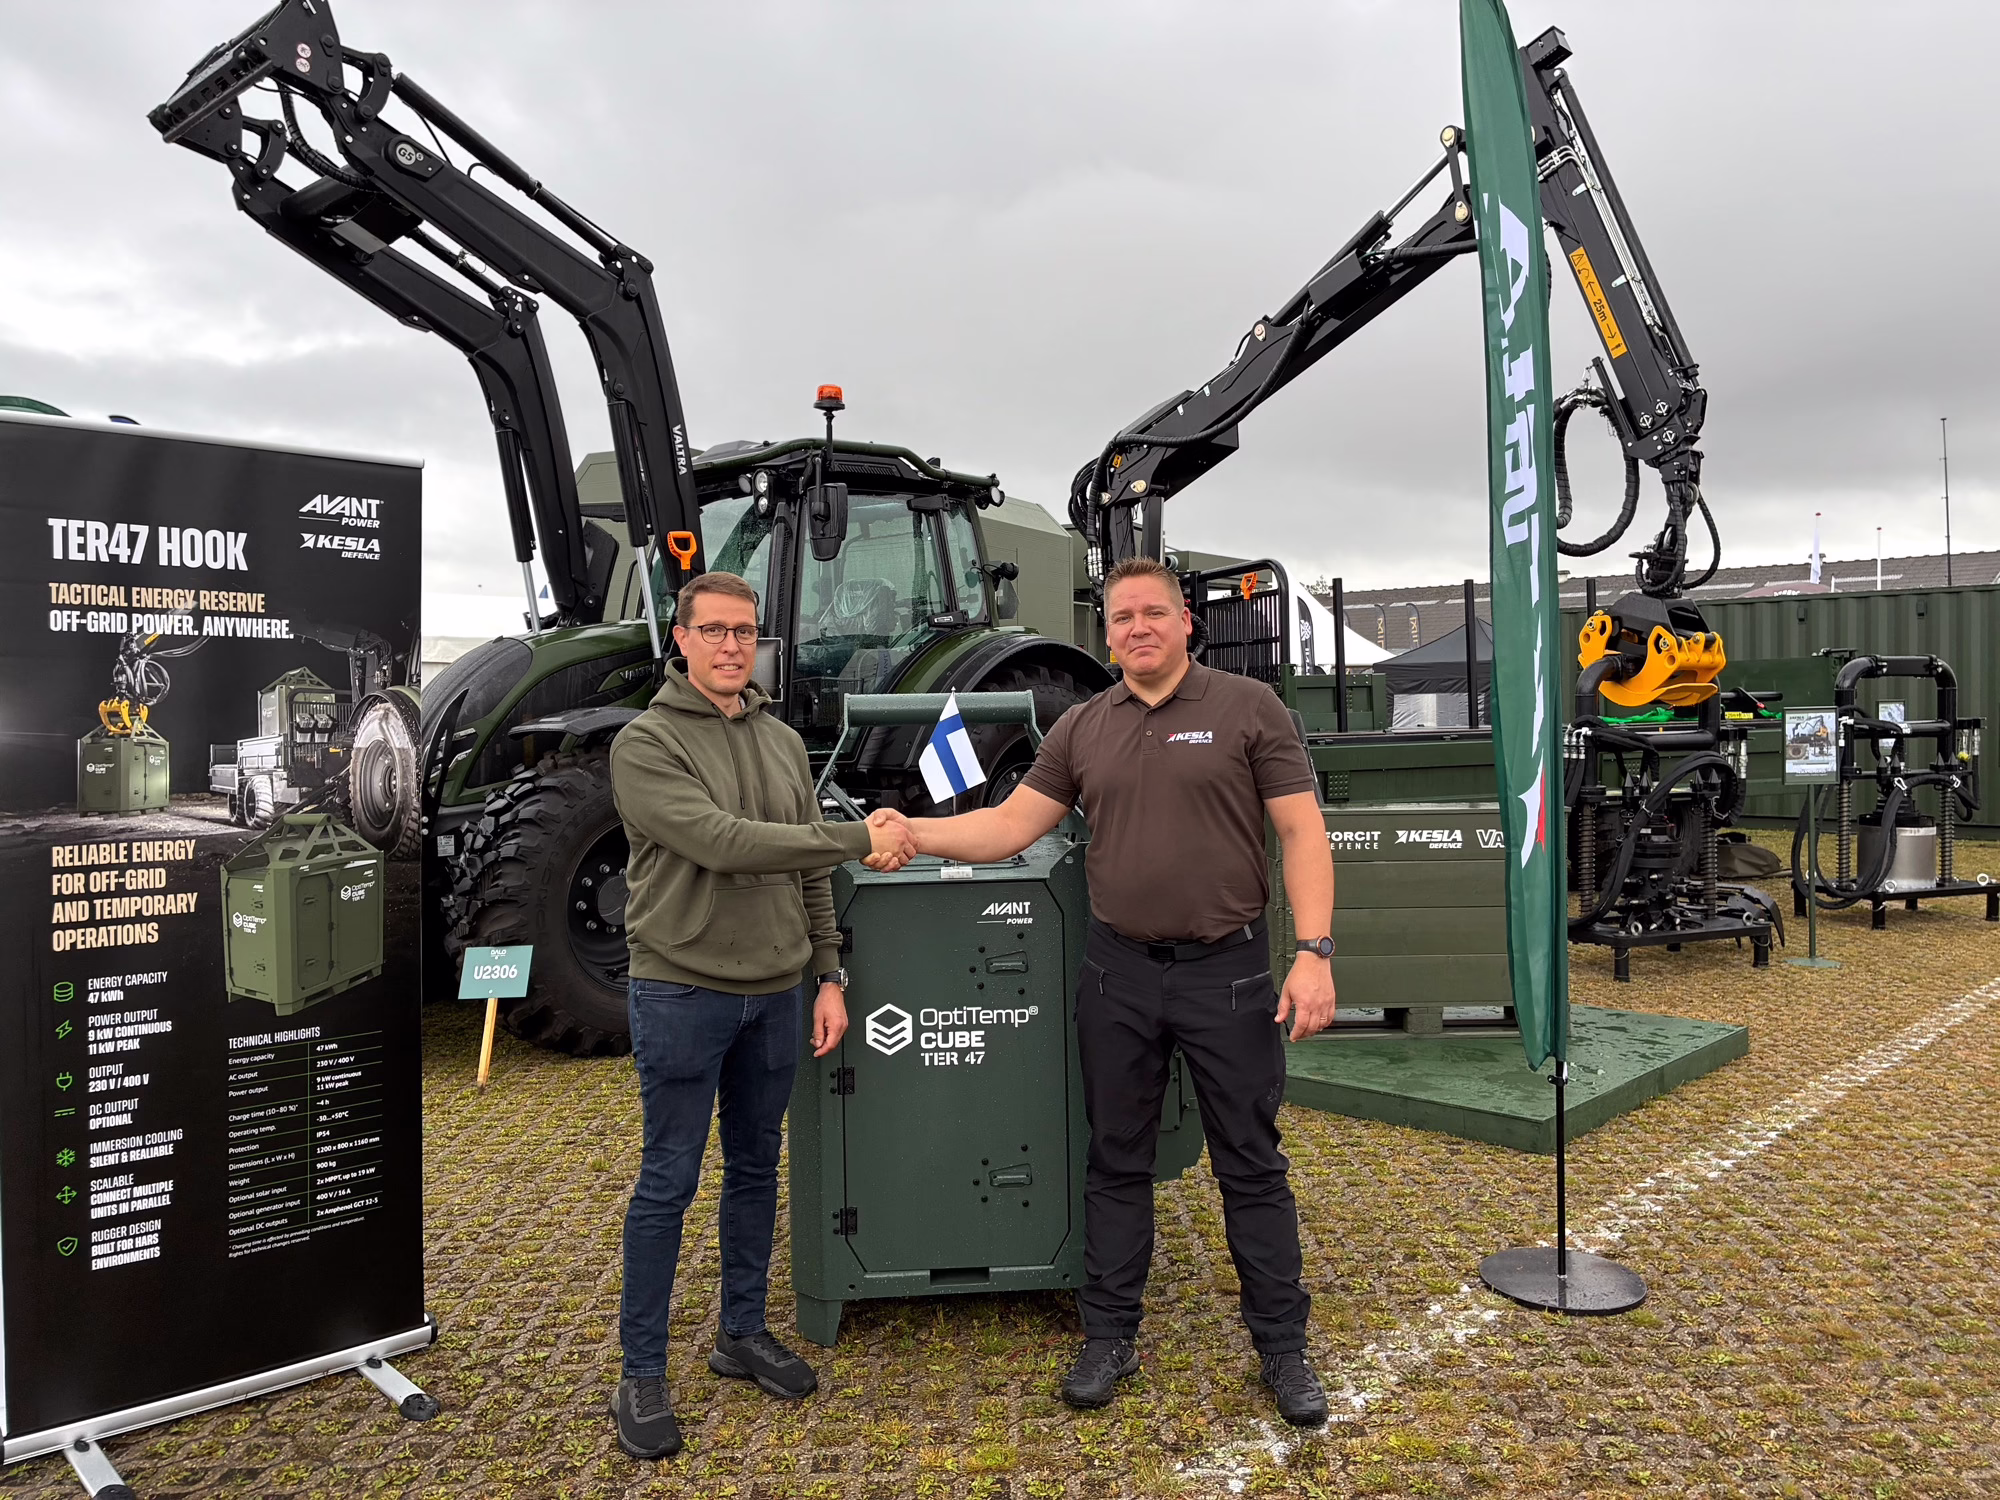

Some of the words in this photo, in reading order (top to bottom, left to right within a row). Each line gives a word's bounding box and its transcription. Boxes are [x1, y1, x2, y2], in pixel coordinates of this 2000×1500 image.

[398, 147, 415, 162] G5
[1593, 298, 1607, 322] 25m
[672, 423, 688, 476] VALTRA
[299, 494, 380, 519] AVANT
[341, 517, 380, 528] POWER
[48, 517, 149, 564] TER47
[158, 526, 248, 571] HOOK
[316, 534, 380, 552] KESLA
[341, 551, 380, 560] DEFENCE
[48, 582, 128, 607] TACTICAL
[132, 587, 195, 612] ENERGY
[199, 590, 265, 613] RESERVE
[49, 609, 128, 633] OFF-GRID
[131, 614, 198, 637] POWER.
[202, 615, 294, 639] ANYWHERE.
[1175, 731, 1213, 741] KESLA
[1408, 829, 1463, 842] KESLA
[52, 842, 128, 867] RELIABLE
[132, 839, 196, 862] ENERGY
[1330, 842, 1379, 850] EFENCE
[52, 872, 85, 896] FOR
[89, 867, 166, 893] OFF-GRID
[52, 900, 89, 924] AND
[93, 892, 198, 920] TEMPORARY
[981, 902, 1031, 916] AVANT
[52, 922, 159, 952] OPERATIONS
[88, 975, 123, 990] ENERGY
[125, 971, 168, 986] CAPACITY
[473, 964, 518, 980] U2306
[87, 991, 100, 1004] 47
[100, 989, 124, 1003] kWh
[88, 1012, 122, 1027] POWER
[123, 1008, 158, 1023] OUTPUT
[88, 1029, 95, 1041] 9
[96, 1027, 113, 1040] kW
[114, 1020, 172, 1038] CONTINUOUS
[228, 1033, 273, 1049] TECHNICAL
[274, 1026, 321, 1044] HIGHLIGHTS
[920, 1030, 985, 1049] CUBE
[88, 1043, 97, 1055] 11
[98, 1040, 115, 1054] kW
[116, 1037, 140, 1052] PEAK
[920, 1051, 959, 1066] TER
[964, 1050, 986, 1065] 47
[89, 1063, 124, 1079] OUTPUT
[88, 1079, 108, 1093] 230
[108, 1077, 116, 1090] V
[122, 1074, 141, 1087] 400
[142, 1073, 149, 1085] V
[89, 1103, 102, 1116] DC
[104, 1097, 139, 1114] OUTPUT
[89, 1112, 133, 1130] OPTIONAL
[90, 1135, 143, 1155] IMMERSION
[145, 1128, 183, 1146] COOLING
[89, 1152, 120, 1168] SILENT
[120, 1151, 128, 1163] &
[90, 1173, 134, 1192] SCALABLE
[90, 1187, 132, 1206] CONNECT
[132, 1179, 174, 1198] MULTIPLE
[90, 1203, 118, 1219] UNITS
[118, 1201, 129, 1214] IN
[130, 1193, 171, 1212] PARALLEL
[129, 1218, 161, 1236] DESIGN
[91, 1241, 116, 1257] BUILT
[116, 1237, 134, 1252] FOR
[91, 1246, 160, 1271] ENVIRONMENTS
